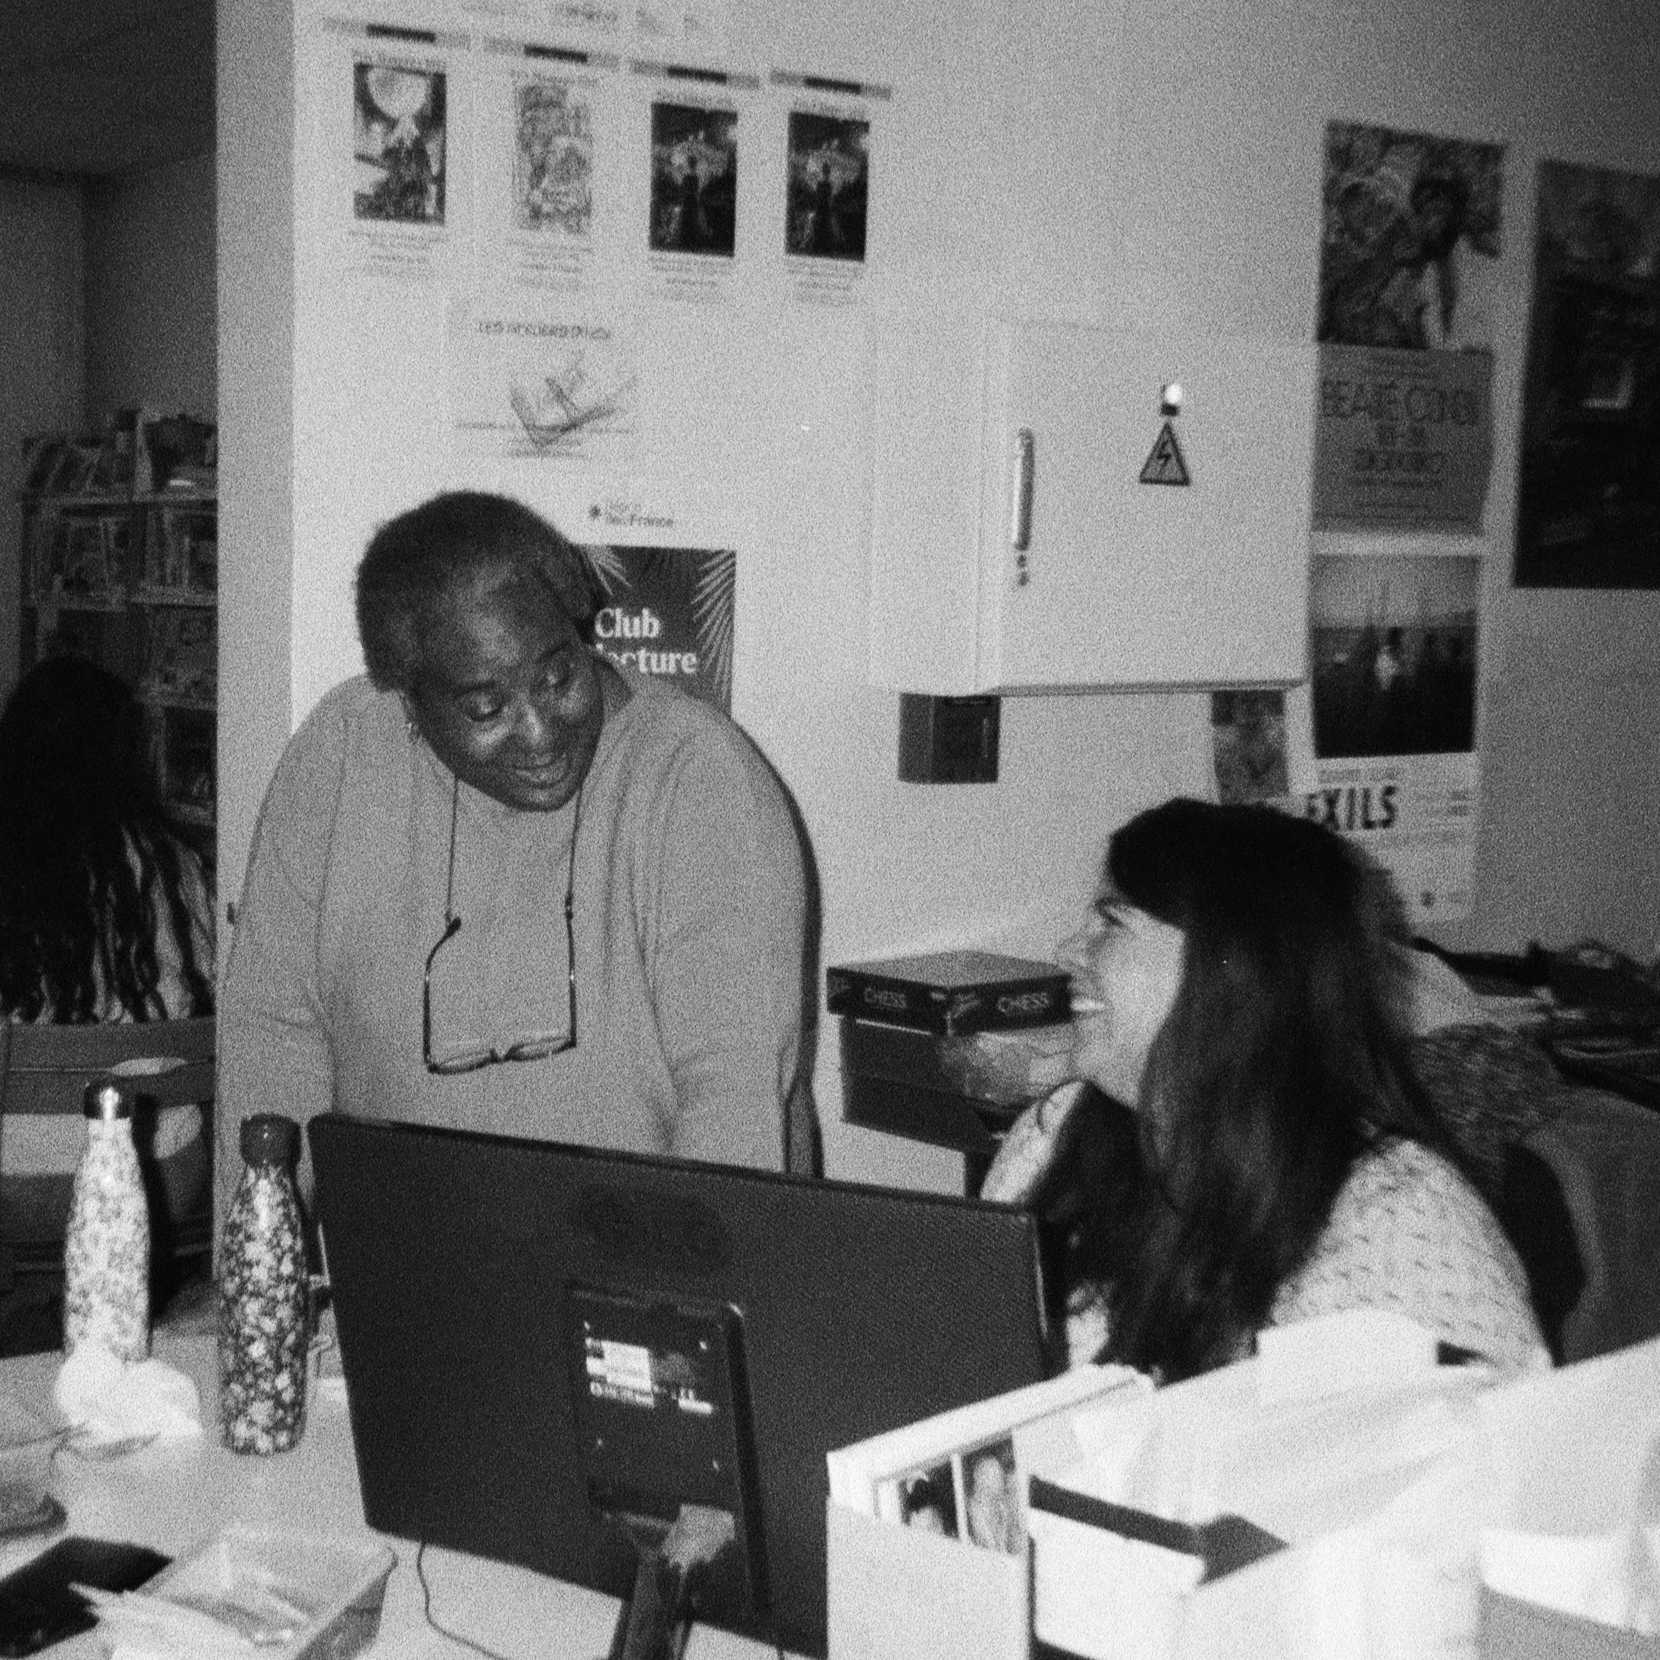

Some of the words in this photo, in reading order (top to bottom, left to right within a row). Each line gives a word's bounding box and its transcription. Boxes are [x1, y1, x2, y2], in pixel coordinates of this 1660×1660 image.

[595, 607, 661, 638] Club
[595, 642, 698, 675] cture
[1306, 784, 1397, 831] EXILS
[863, 986, 907, 1010] CHESS
[996, 990, 1051, 1014] CHESS
